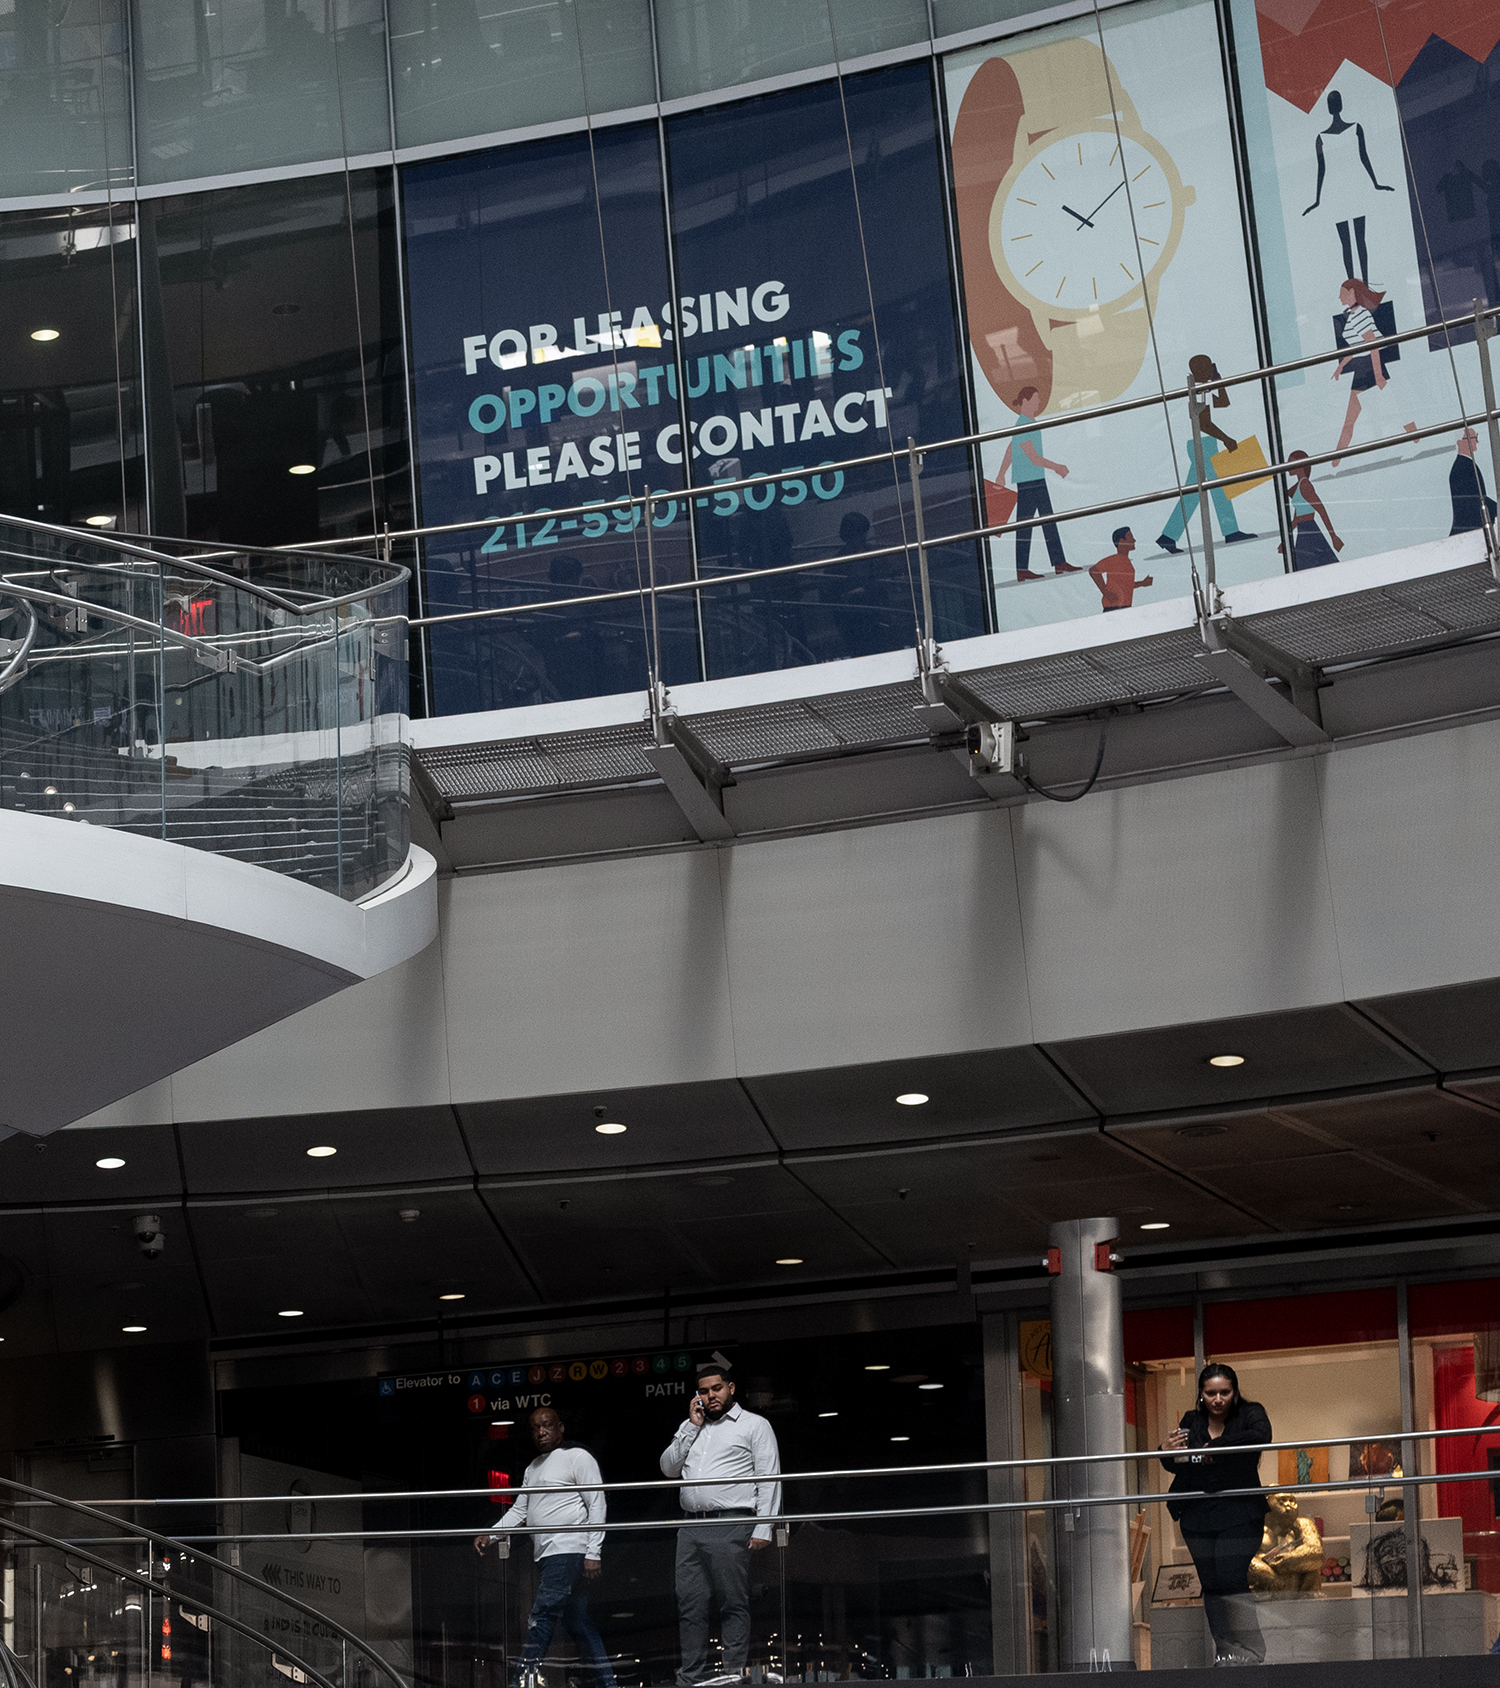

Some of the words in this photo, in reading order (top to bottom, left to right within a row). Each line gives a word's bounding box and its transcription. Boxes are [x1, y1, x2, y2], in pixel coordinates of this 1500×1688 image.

[463, 322, 558, 376] FOR
[574, 280, 790, 354] LEASING
[468, 329, 865, 434] OPPORTUNITIES
[473, 431, 643, 495] PLEASE
[655, 386, 894, 465] CONTACT
[395, 1376, 443, 1390] Elevator
[447, 1373, 461, 1385] to
[645, 1381, 686, 1397] PATH
[489, 1399, 511, 1411] via
[514, 1393, 552, 1408] WTC
[284, 1568, 304, 1588] THIS
[306, 1572, 327, 1591] WAY
[327, 1576, 341, 1595] TO
